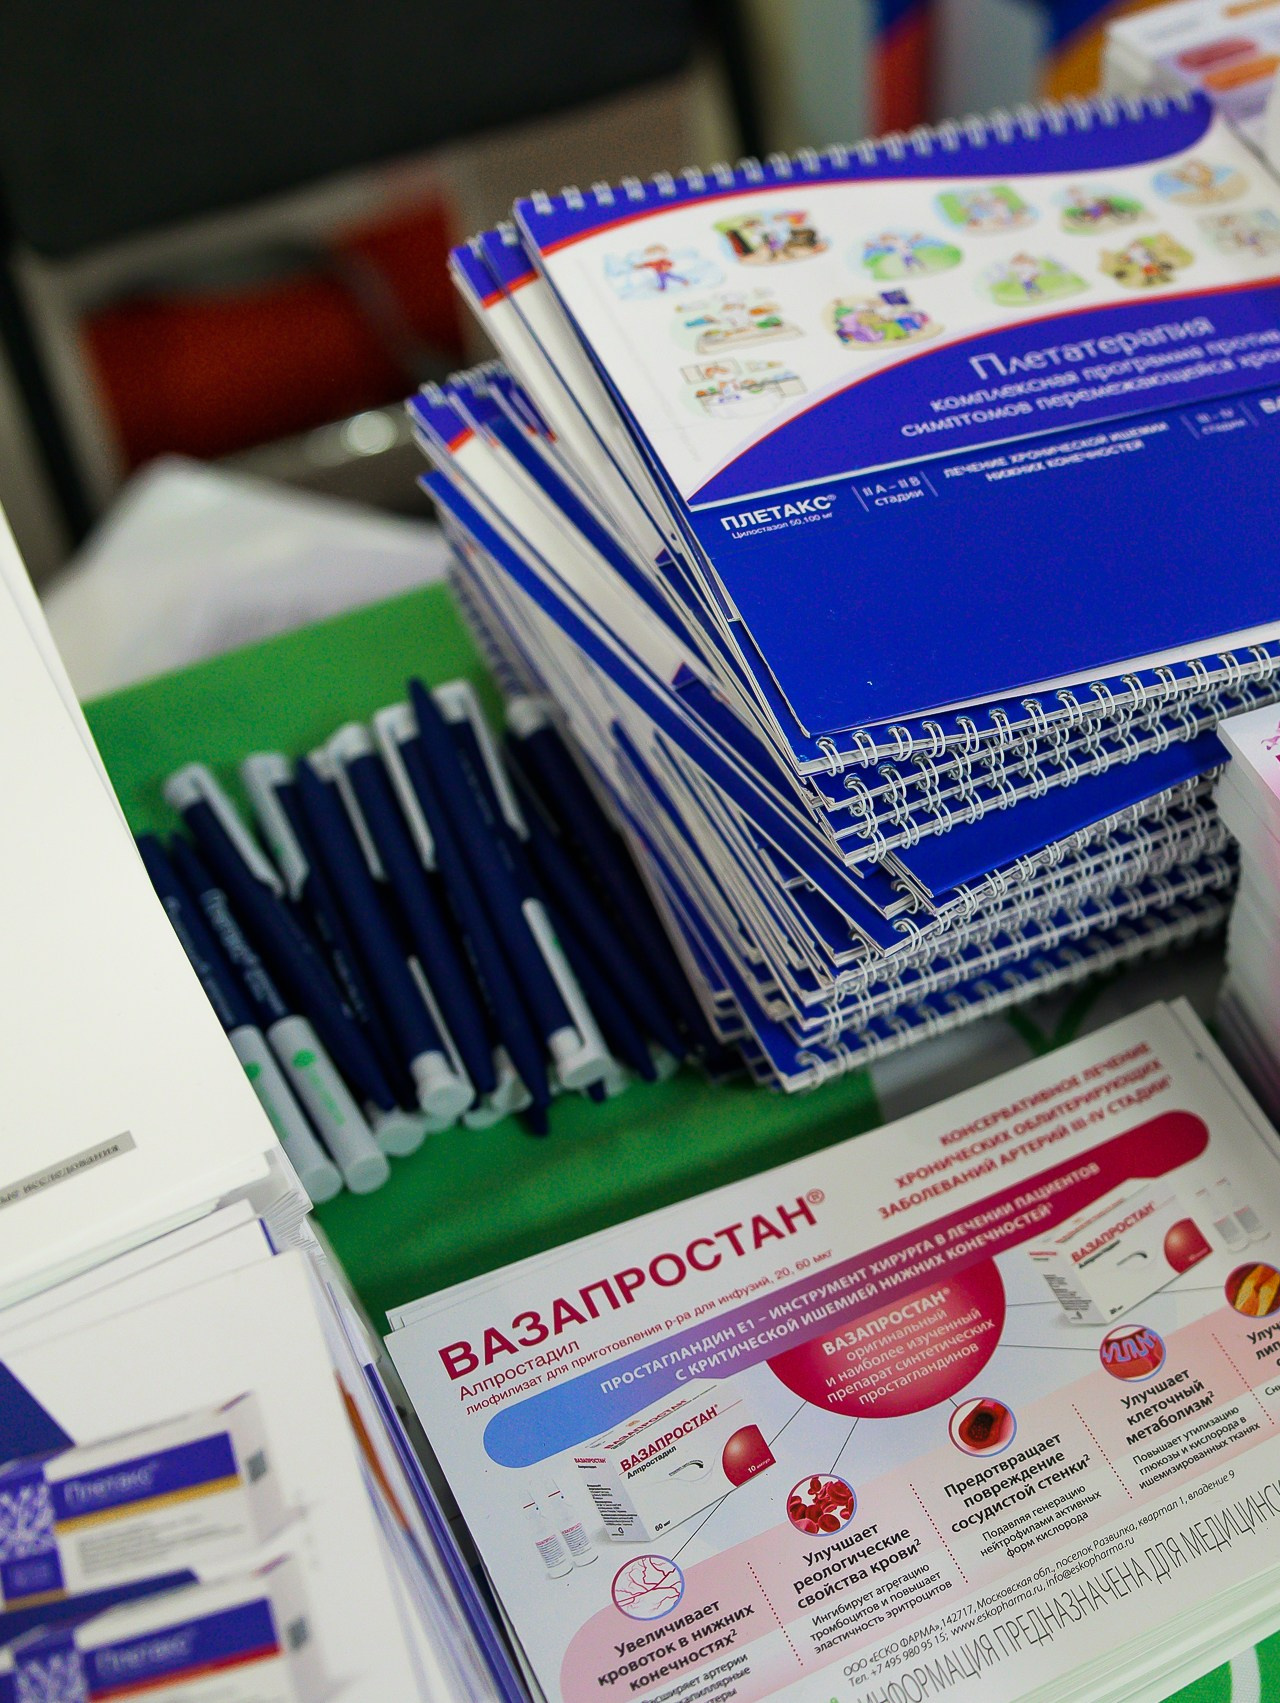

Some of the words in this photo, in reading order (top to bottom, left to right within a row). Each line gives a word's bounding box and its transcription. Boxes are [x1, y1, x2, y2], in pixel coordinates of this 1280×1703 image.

[967, 315, 1215, 381] Плетатерапия
[599, 1326, 736, 1394] ПРОСТАГЛАНДИН
[767, 1266, 867, 1320] ИНСТРУМЕНТ
[867, 1238, 935, 1275] ХИРУРГА
[945, 1201, 1015, 1241] ЛЕЧЕНИИ
[1012, 1161, 1101, 1210] ПАЦИЕНТОВ
[465, 1373, 543, 1416] лиофилизат
[569, 1322, 663, 1369] приготовления
[663, 1310, 692, 1331] р-ра
[716, 1275, 774, 1305] инфузий,
[686, 1316, 800, 1376] КРИТИЧЕСКОЙ
[799, 1282, 879, 1326] ИШЕМИЕЙ
[877, 1252, 946, 1291] НИЖНИХ
[836, 1344, 905, 1382] наиболее
[905, 1306, 982, 1350] изученный
[845, 1306, 948, 1362] оригинальный
[459, 1339, 580, 1402] Алпростадил
[825, 1365, 893, 1404] препарат
[894, 1317, 996, 1371] синтетических
[857, 1341, 979, 1405] простагландинов
[1119, 1368, 1190, 1410] Улучшает
[1125, 1378, 1205, 1426] клеточный
[625, 1444, 677, 1479] Алпростадил
[942, 1433, 1061, 1498] Предотвращает
[1131, 1434, 1183, 1465] Повышает
[1181, 1405, 1240, 1442] утилизацию
[1137, 1438, 1229, 1490] ишемизированных
[1226, 1421, 1261, 1443] тканях
[1138, 1449, 1181, 1476] глюкозы
[1187, 1419, 1240, 1451] кислорода
[950, 1482, 1037, 1533] сосудистой
[962, 1451, 1066, 1508] повреждение
[801, 1523, 878, 1567] Улучшает
[979, 1513, 1055, 1557] нейтрофилами
[1053, 1490, 1102, 1519] активных
[980, 1511, 1032, 1542] Подавляя
[1030, 1484, 1086, 1517] генерацию
[1005, 1537, 1036, 1559] форм
[1034, 1510, 1089, 1543] кислорода
[791, 1528, 911, 1595] реологические
[796, 1568, 869, 1609] свойства
[808, 1602, 881, 1642] тромбоцитов
[888, 1570, 941, 1603] повышает
[810, 1589, 874, 1627] Ингибирует
[874, 1563, 930, 1596] агрегацию
[813, 1614, 885, 1654] эластичность
[884, 1579, 953, 1619] эритроцитов
[847, 1672, 867, 1687] Тел.
[949, 1581, 1046, 1636] www.eskopharma.ru,
[1043, 1535, 1135, 1588] info@eskopharma.ru
[868, 1641, 900, 1663] «ЕСКО
[1031, 1565, 1056, 1584] обл.,
[1054, 1543, 1096, 1570] поселок
[991, 1548, 1153, 1657] ПРЕДНАЗНАЧЕНА
[596, 1640, 677, 1687] кровоток
[689, 1603, 755, 1642] нижних
[612, 1599, 720, 1658] Увеличивает
